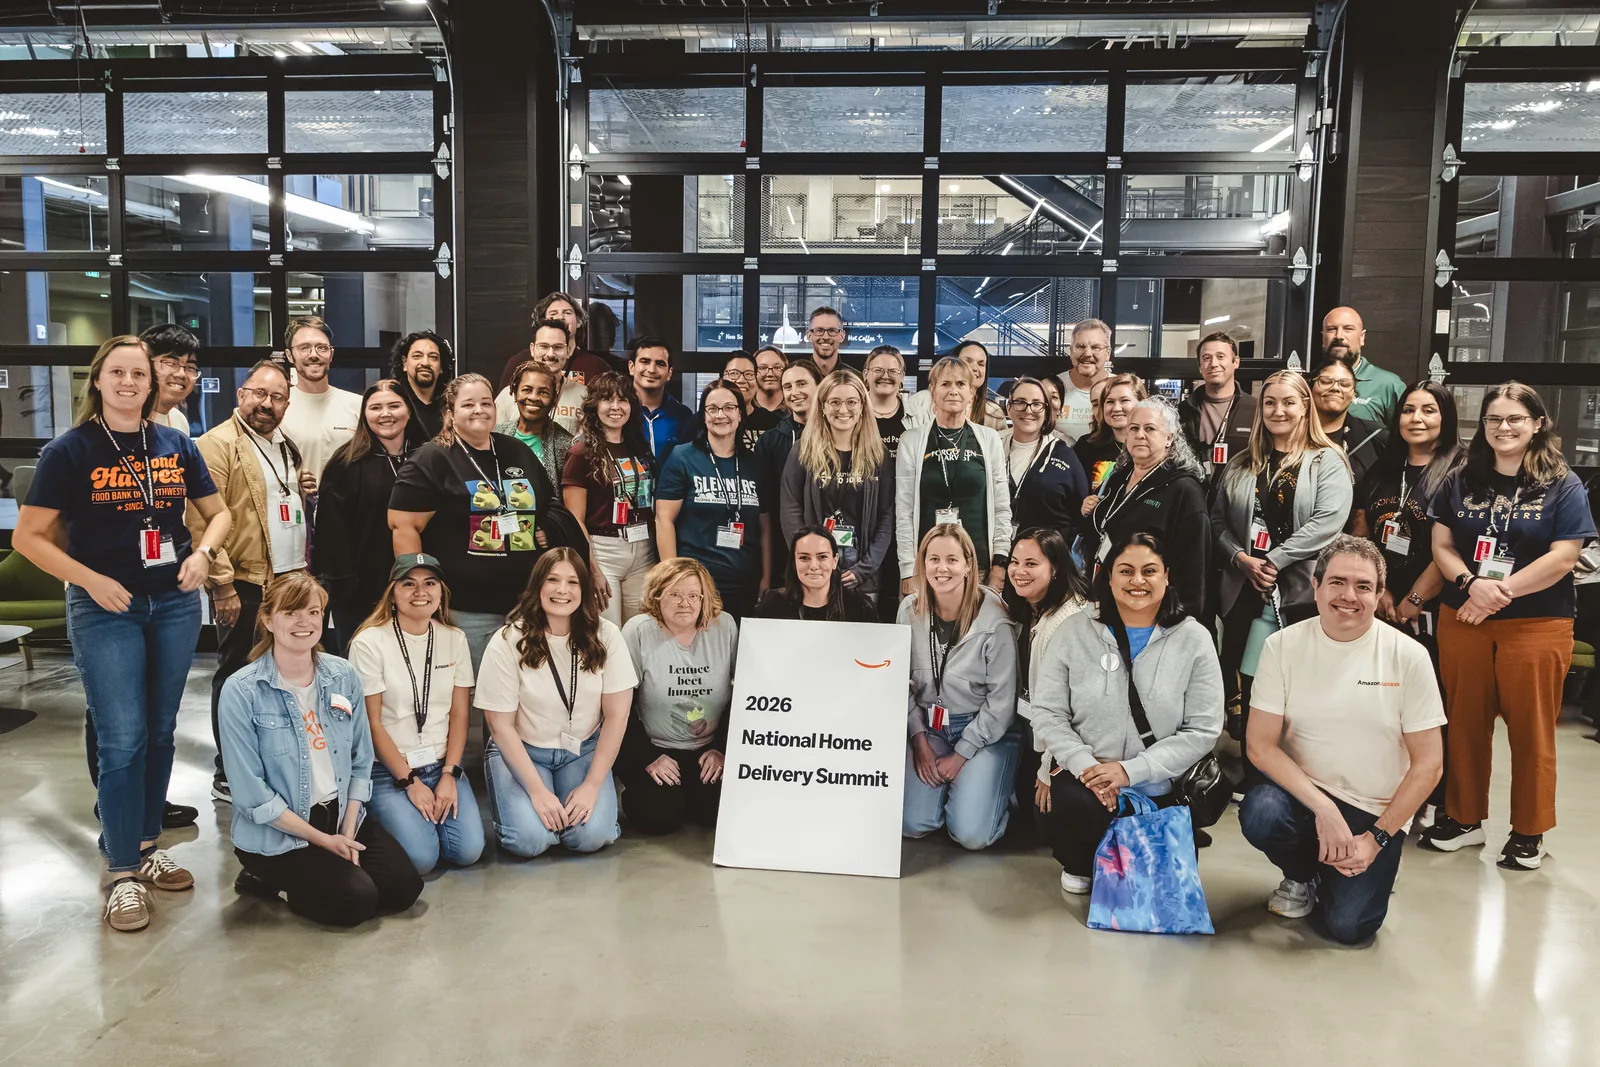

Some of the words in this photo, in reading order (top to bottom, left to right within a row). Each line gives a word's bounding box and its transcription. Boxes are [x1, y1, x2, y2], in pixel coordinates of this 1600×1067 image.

[858, 335, 875, 343] Coffee
[91, 492, 110, 501] FOOD
[111, 490, 132, 500] BANK
[124, 501, 144, 511] SINCE
[1457, 510, 1542, 520] GLENERS
[669, 664, 710, 674] Lettuce
[677, 676, 702, 685] beet
[668, 687, 713, 698] hunger
[745, 695, 792, 712] 2026
[741, 729, 816, 748] National
[819, 733, 872, 751] Home
[738, 763, 813, 786] Delivery
[815, 767, 889, 787] Summit
